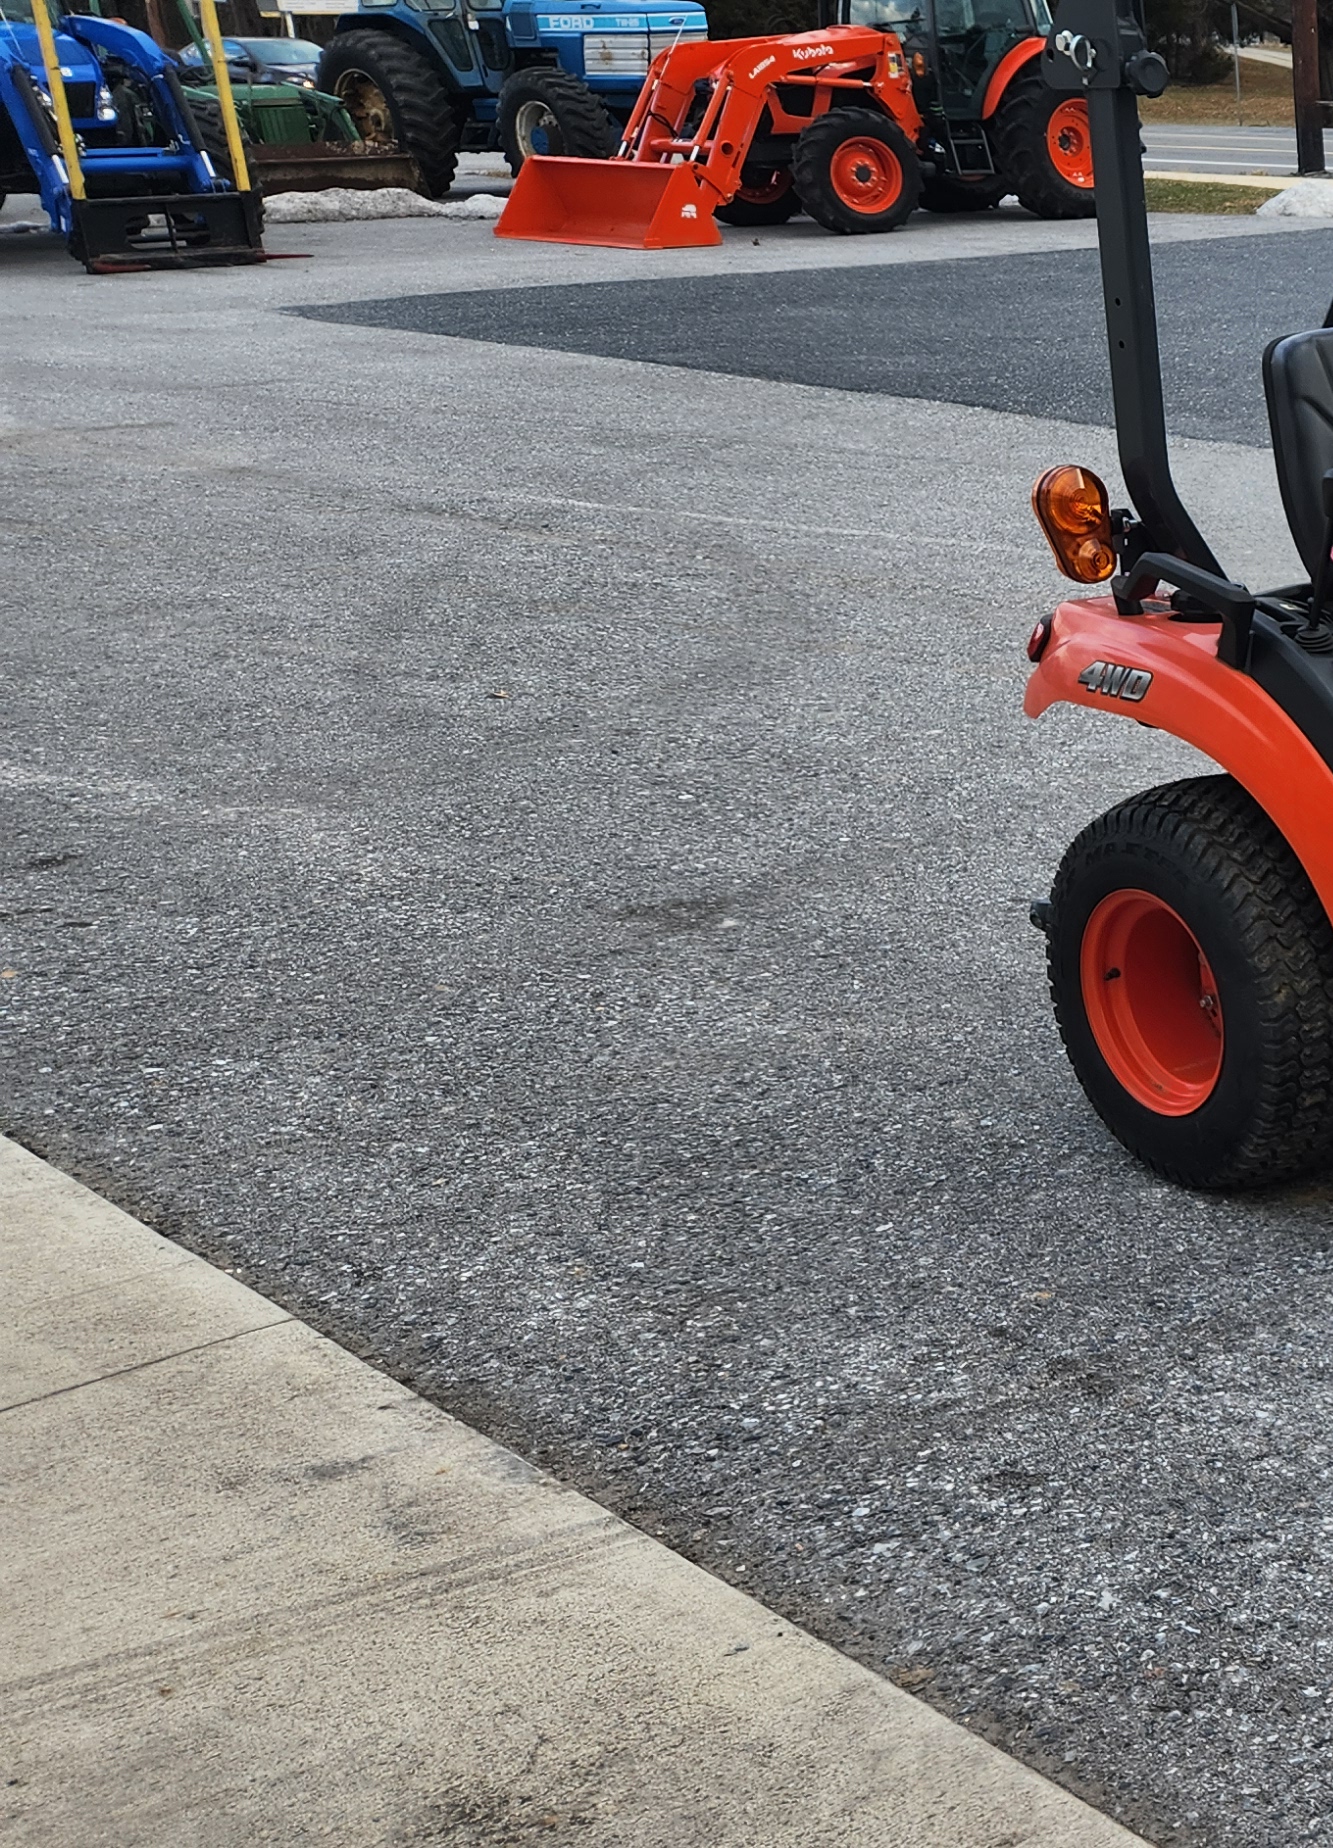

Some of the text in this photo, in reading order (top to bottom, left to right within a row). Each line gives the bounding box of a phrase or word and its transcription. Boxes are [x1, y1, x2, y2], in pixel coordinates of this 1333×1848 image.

[549, 15, 595, 30] FORD
[792, 44, 834, 60] Kubota
[1078, 660, 1154, 703] 4WD
